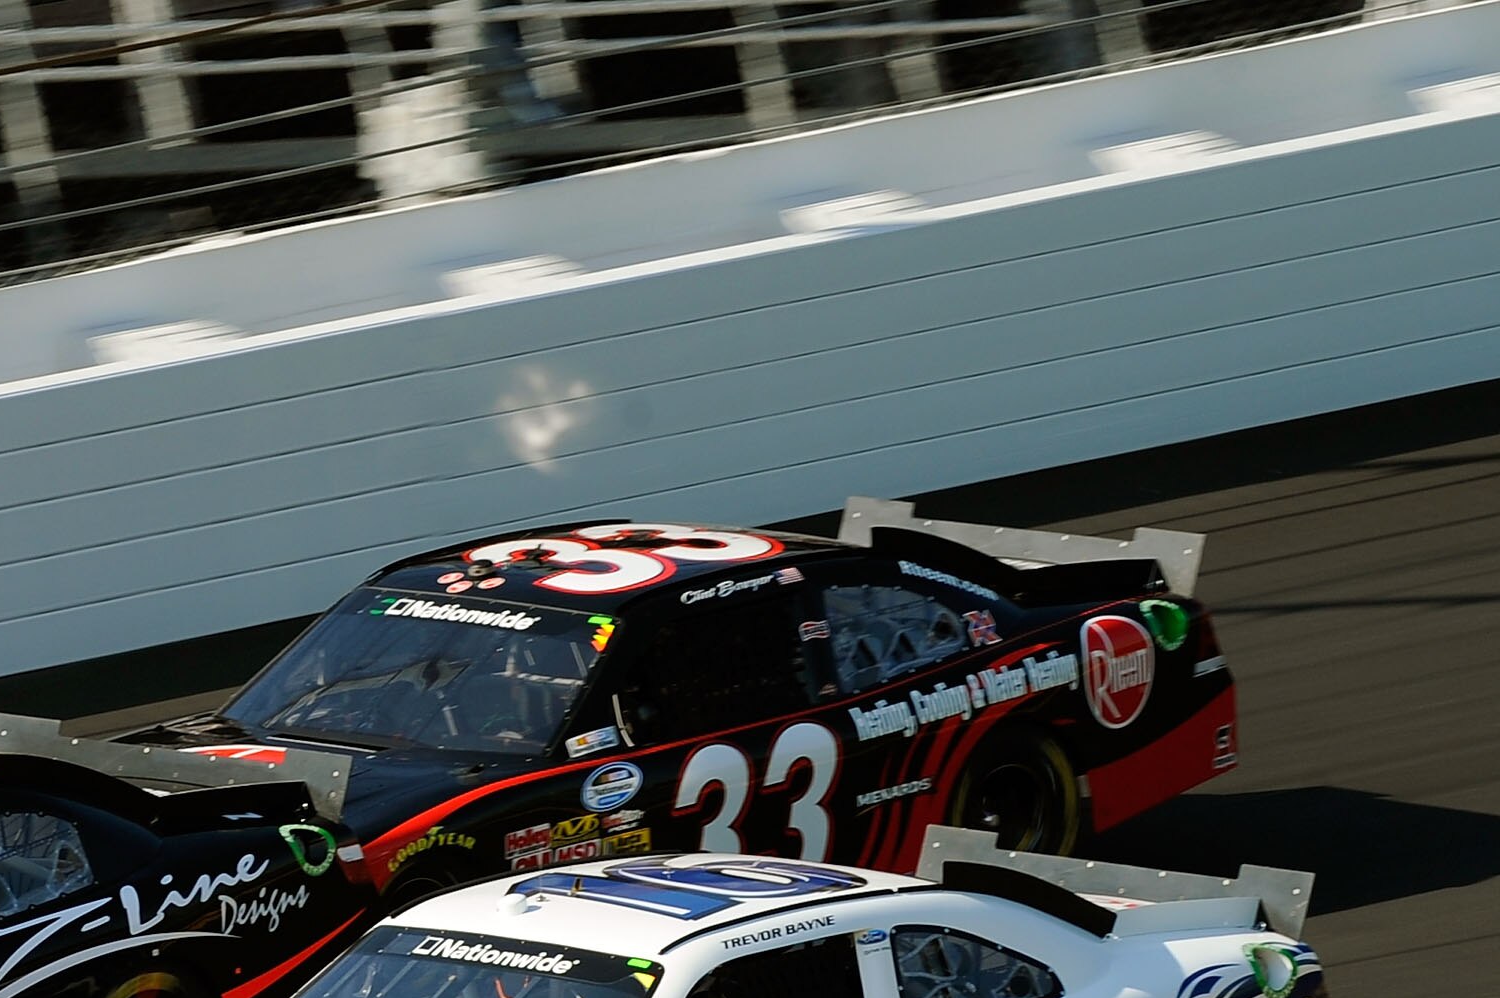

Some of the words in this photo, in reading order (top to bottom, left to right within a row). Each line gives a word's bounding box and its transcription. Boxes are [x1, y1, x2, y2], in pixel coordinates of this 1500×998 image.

[463, 522, 785, 596] 33
[408, 599, 541, 632] Nationwide
[966, 674, 987, 709] &
[673, 721, 841, 862] 33
[856, 777, 932, 807] MENARDS
[387, 830, 477, 872] GOODYEAR
[507, 854, 868, 921] 16
[218, 884, 310, 935] Designs
[721, 927, 783, 949] TREVOR
[786, 915, 837, 935] BAYNE
[434, 938, 573, 976] Nationwide
